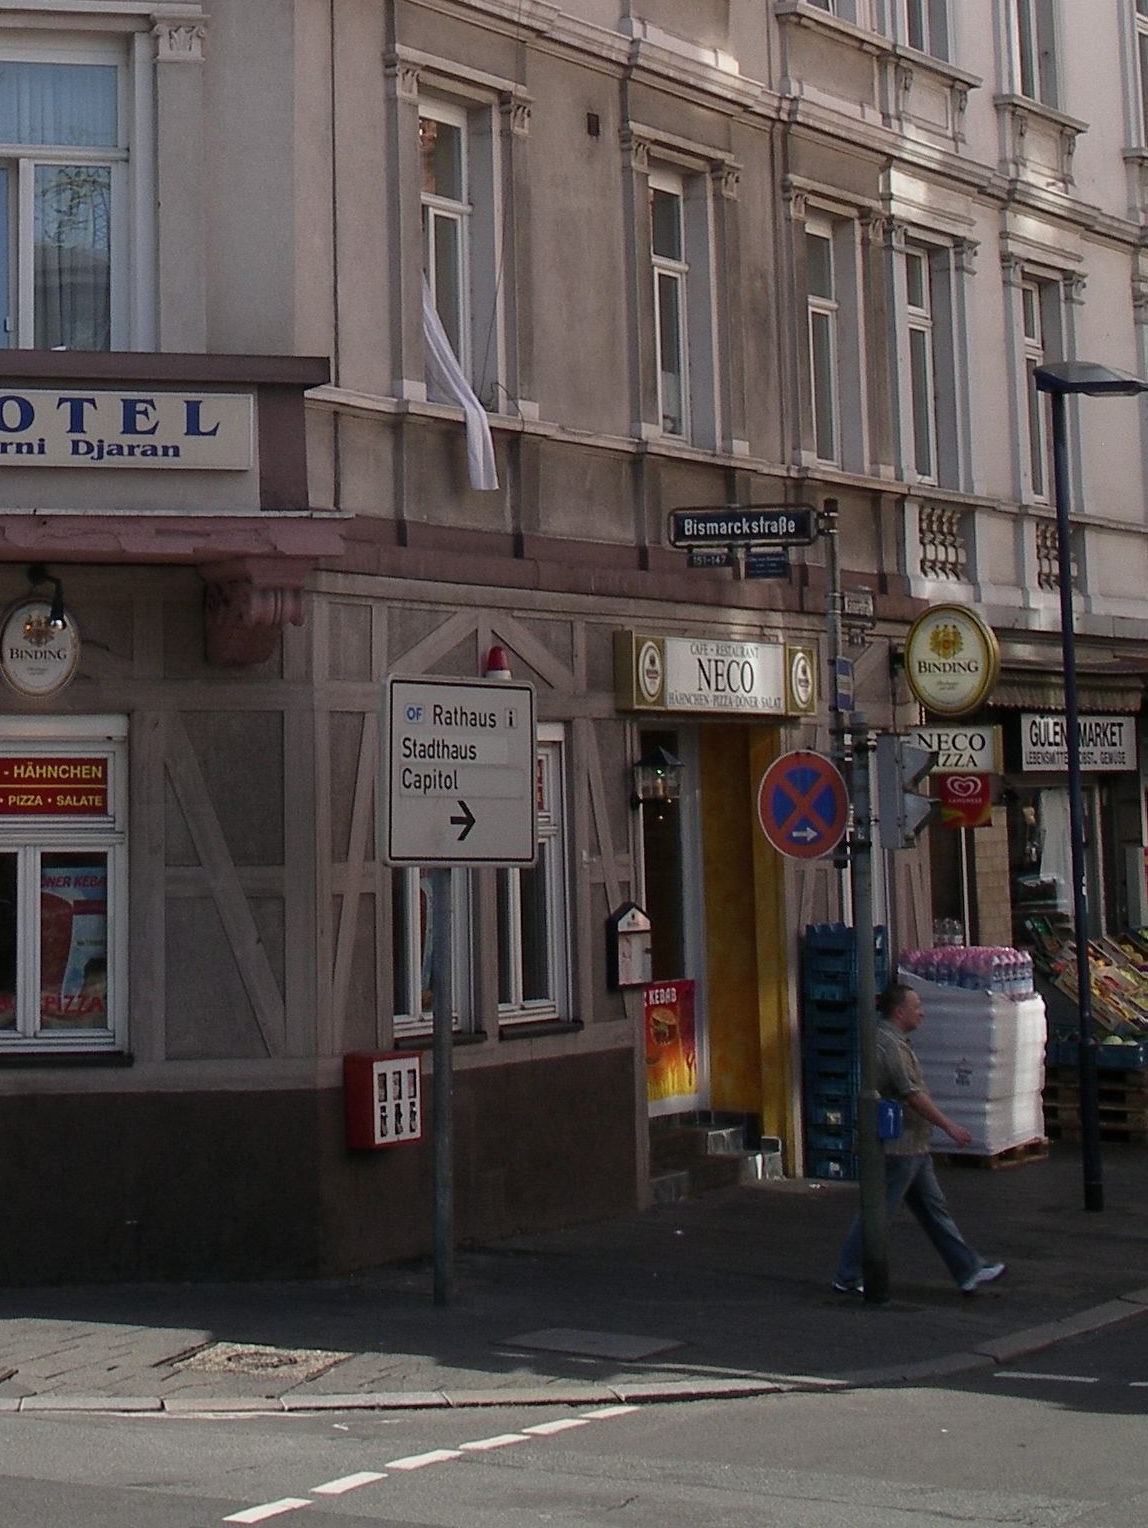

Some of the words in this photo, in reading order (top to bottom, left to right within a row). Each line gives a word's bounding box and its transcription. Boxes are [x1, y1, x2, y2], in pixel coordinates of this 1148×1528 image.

[70, 439, 181, 460] Djaran
[684, 516, 796, 536] Bismarckstraße
[10, 648, 67, 660] BINDING
[697, 658, 754, 693] NECO
[917, 661, 979, 673] BINDING
[433, 704, 497, 728] Rathaus
[917, 733, 986, 752] NECO
[1078, 722, 1124, 747] MARKET
[402, 737, 477, 760] Stadthaus
[14, 762, 102, 778] HÄHNCHEN
[402, 767, 458, 795] Capitol
[8, 795, 43, 806] PIZZA
[56, 795, 102, 806] SALATE
